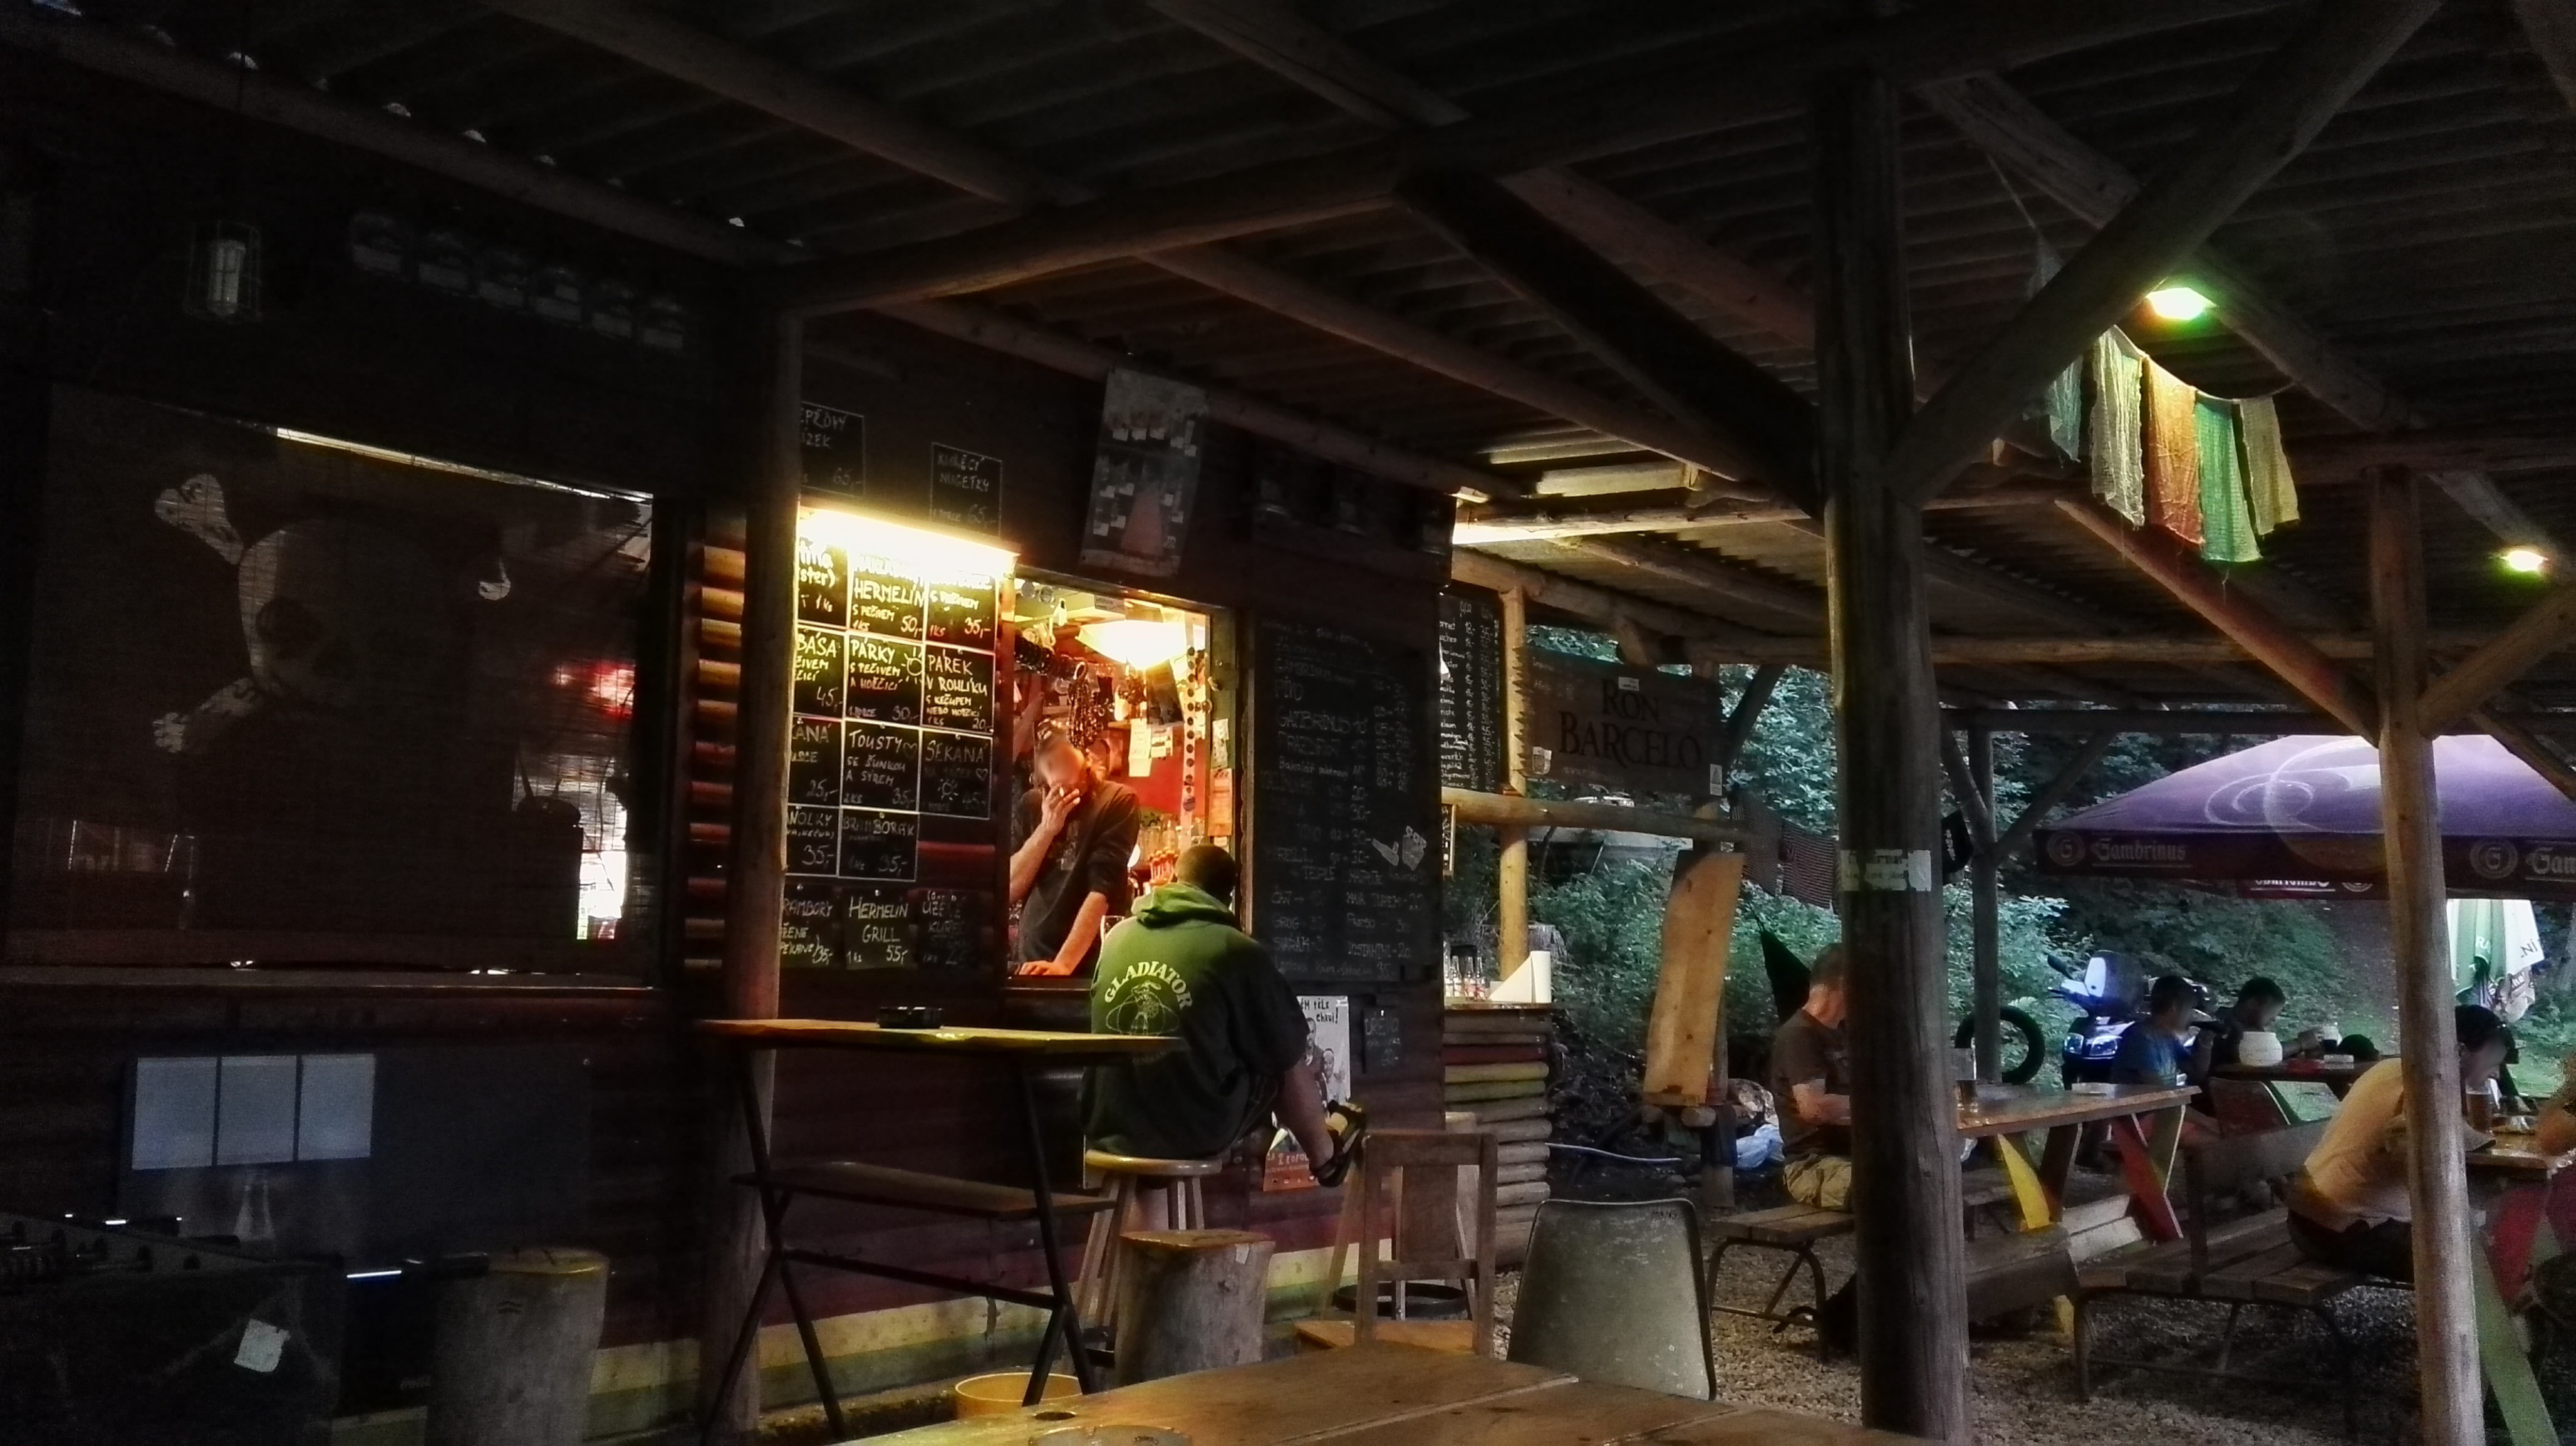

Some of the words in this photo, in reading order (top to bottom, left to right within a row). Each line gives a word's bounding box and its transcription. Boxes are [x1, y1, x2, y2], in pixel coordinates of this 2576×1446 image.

[854, 577, 925, 608] HERMELÍN
[850, 637, 895, 665] PÁRKY
[927, 648, 974, 676] PÁREK
[938, 676, 988, 697] ROHLÍKU
[1601, 677, 1660, 724] RON
[849, 729, 903, 753] TOUSTY
[925, 740, 989, 764] SEKANÁ
[1558, 711, 1702, 771] BARCELÓ
[2091, 838, 2186, 861] Gambrinus
[862, 923, 901, 943] GRILL
[1104, 961, 1192, 1009] GLADIATOR
